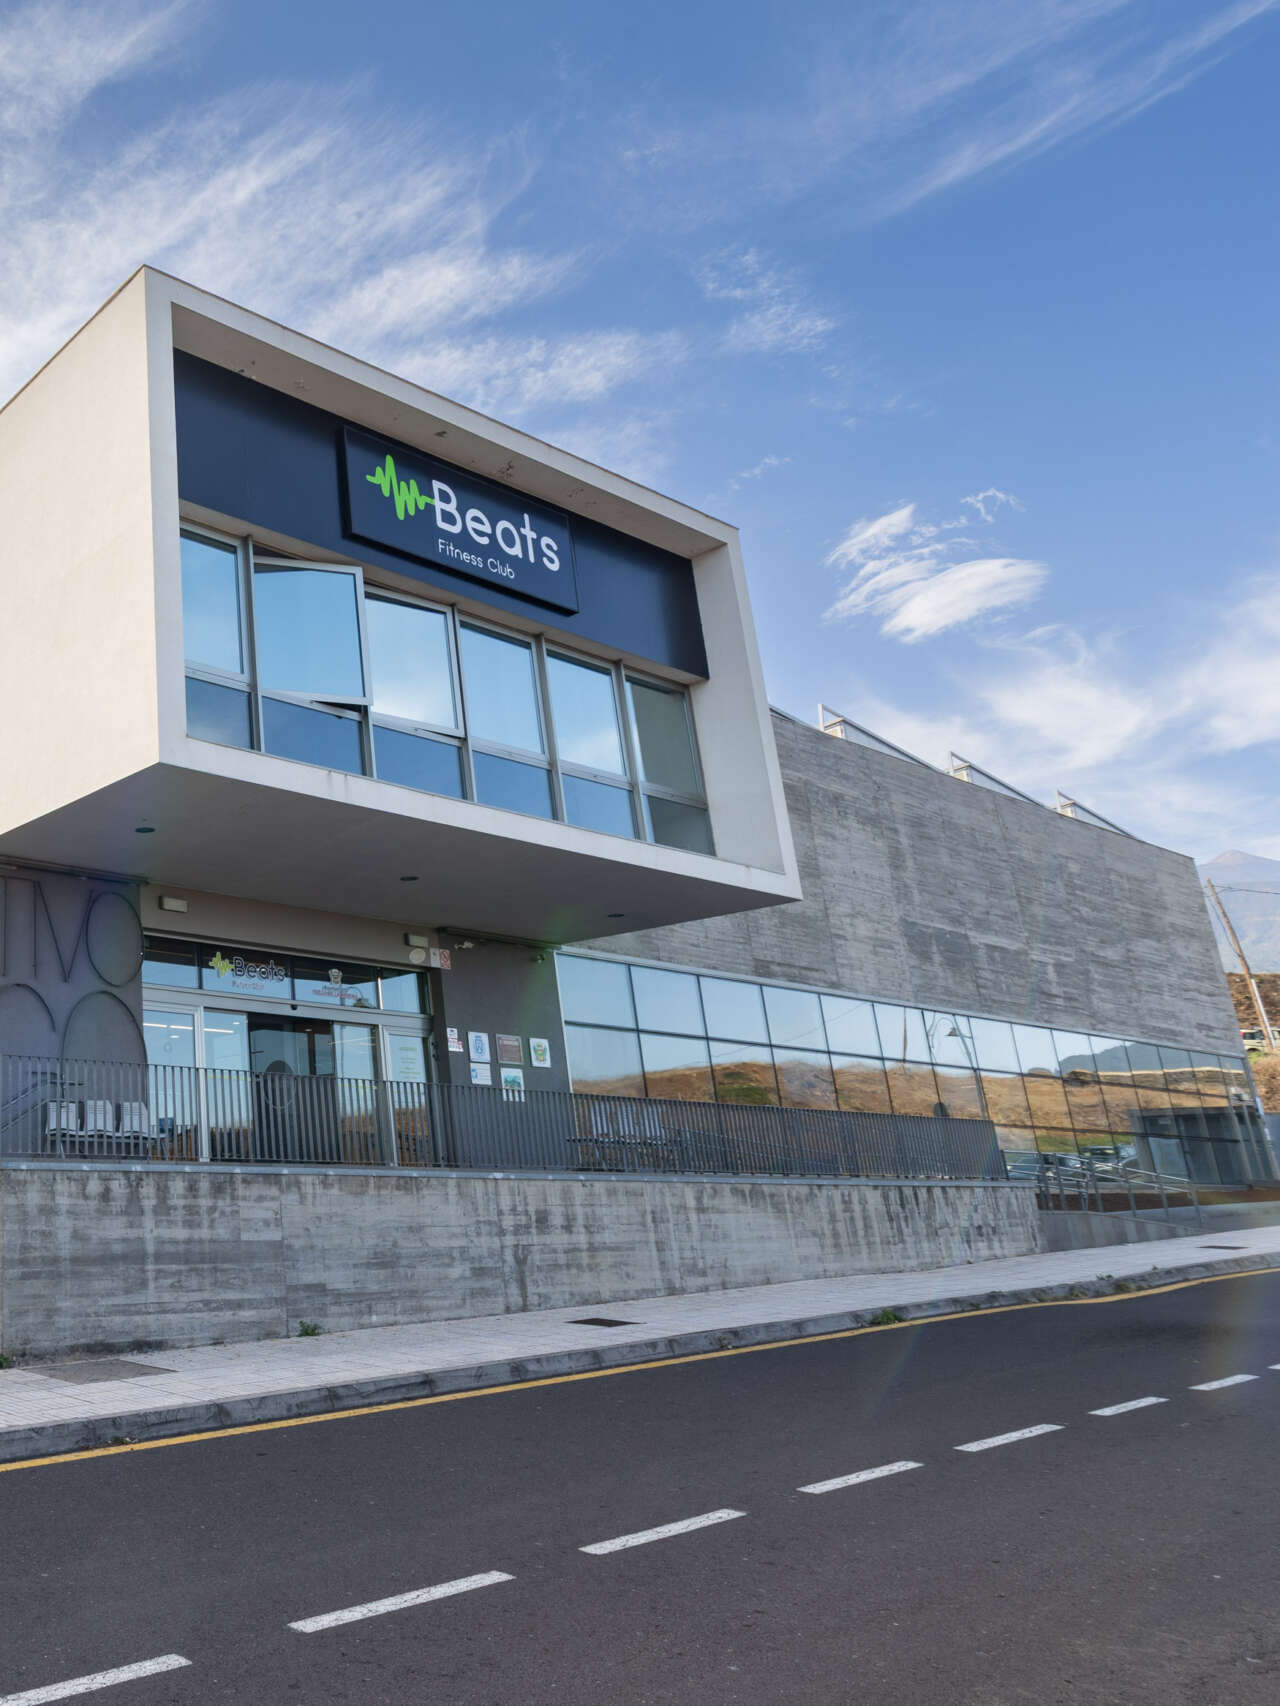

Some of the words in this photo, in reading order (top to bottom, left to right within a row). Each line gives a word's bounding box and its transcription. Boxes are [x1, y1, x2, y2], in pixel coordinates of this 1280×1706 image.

[432, 479, 561, 572] Beats
[438, 538, 484, 568] Fitness
[487, 557, 516, 579] Club
[233, 956, 286, 981] Beats
